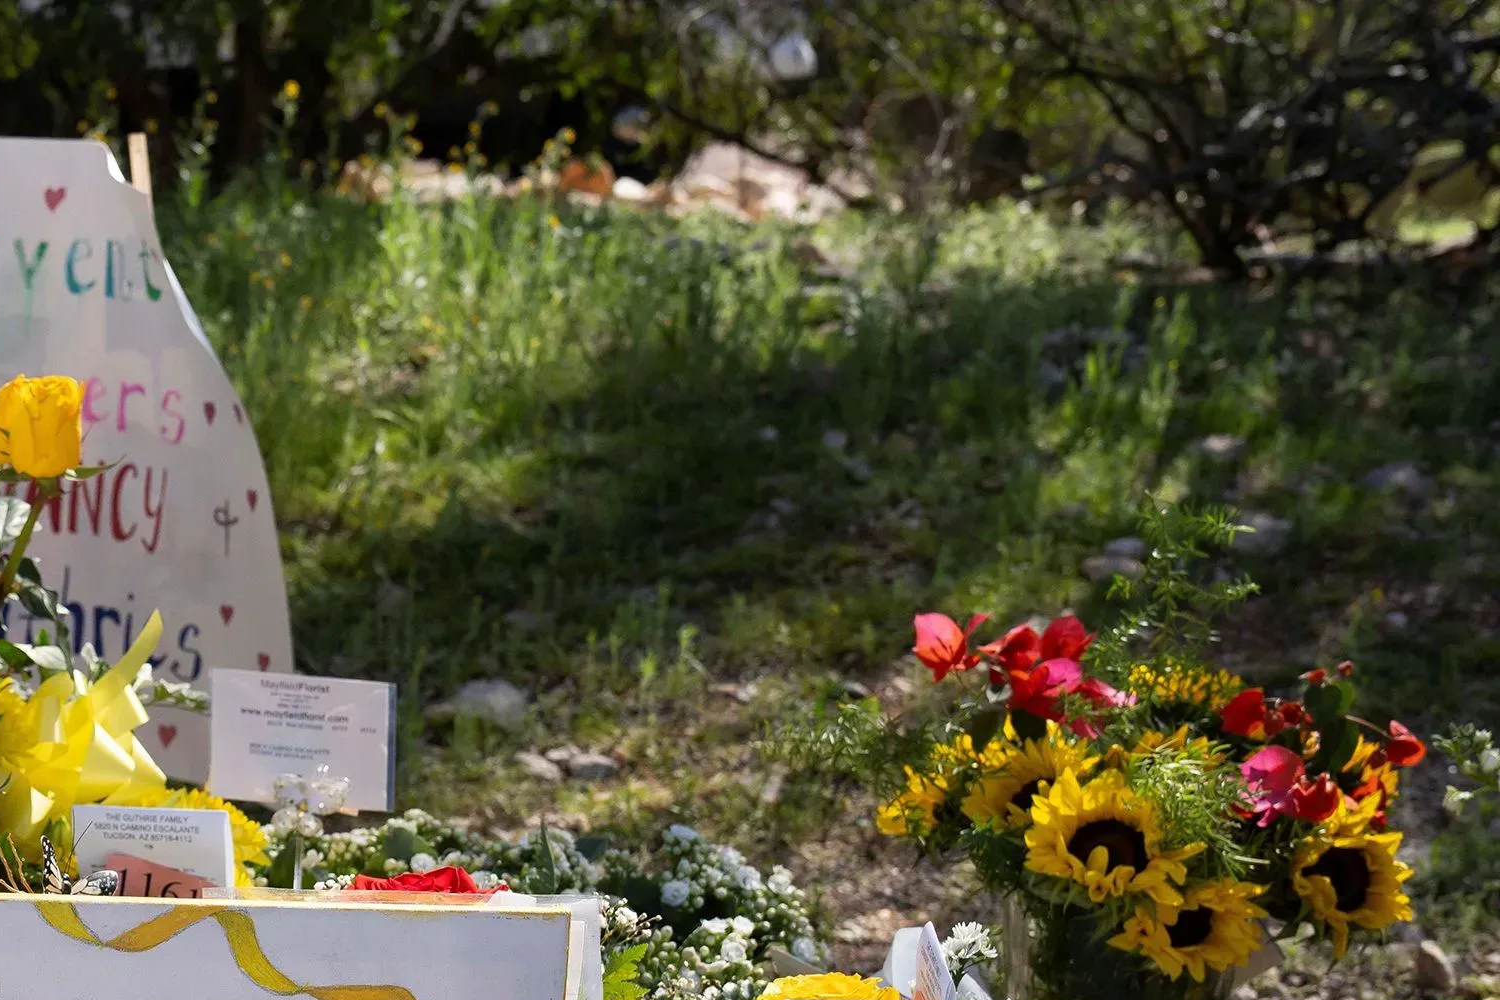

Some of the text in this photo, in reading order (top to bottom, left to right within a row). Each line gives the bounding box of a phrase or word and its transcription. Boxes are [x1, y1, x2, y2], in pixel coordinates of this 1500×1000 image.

[106, 813, 189, 824] THE GUTHRIE FAMILY
[119, 823, 152, 832] CAMINO
[153, 825, 200, 834] ESCALANTE
